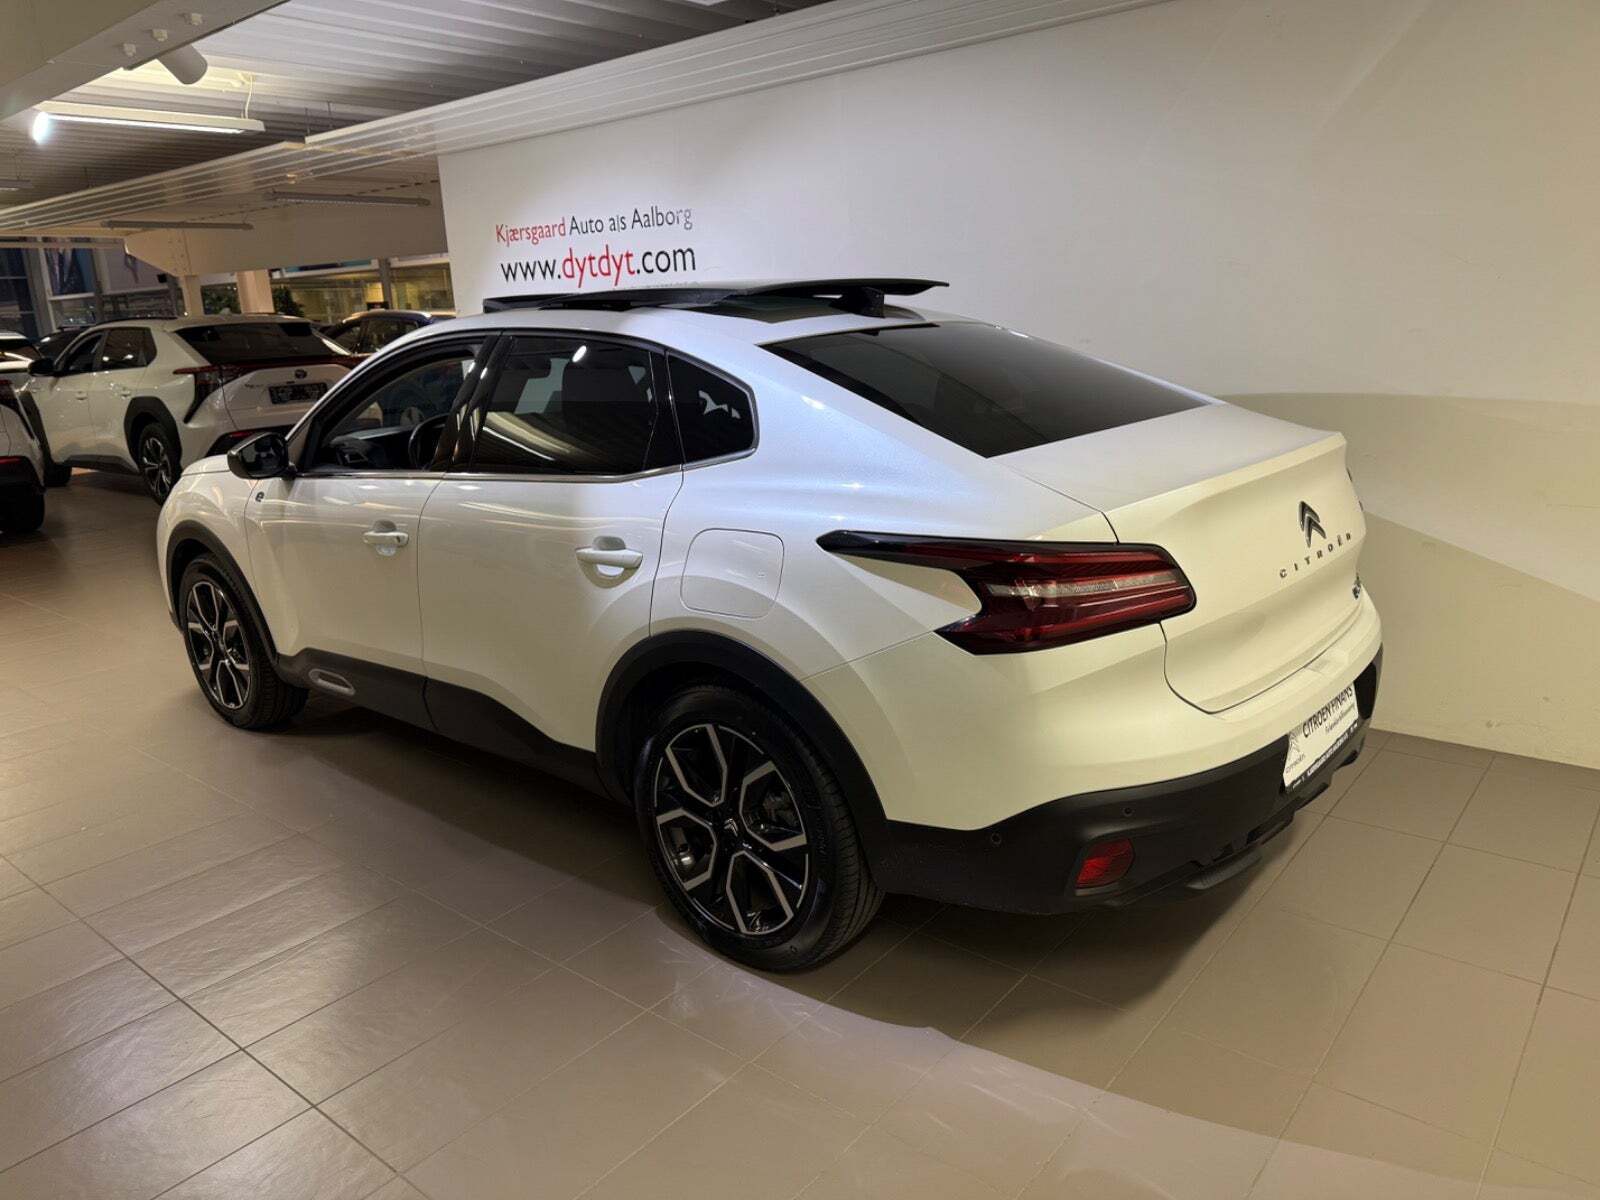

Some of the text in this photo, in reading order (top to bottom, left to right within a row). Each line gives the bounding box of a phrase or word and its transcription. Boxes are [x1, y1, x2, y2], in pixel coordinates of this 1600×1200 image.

[495, 216, 566, 248] Kjærsgaard
[569, 215, 604, 235] Auto
[631, 205, 693, 231] Aalborg
[500, 244, 697, 289] www.dytdyt.com
